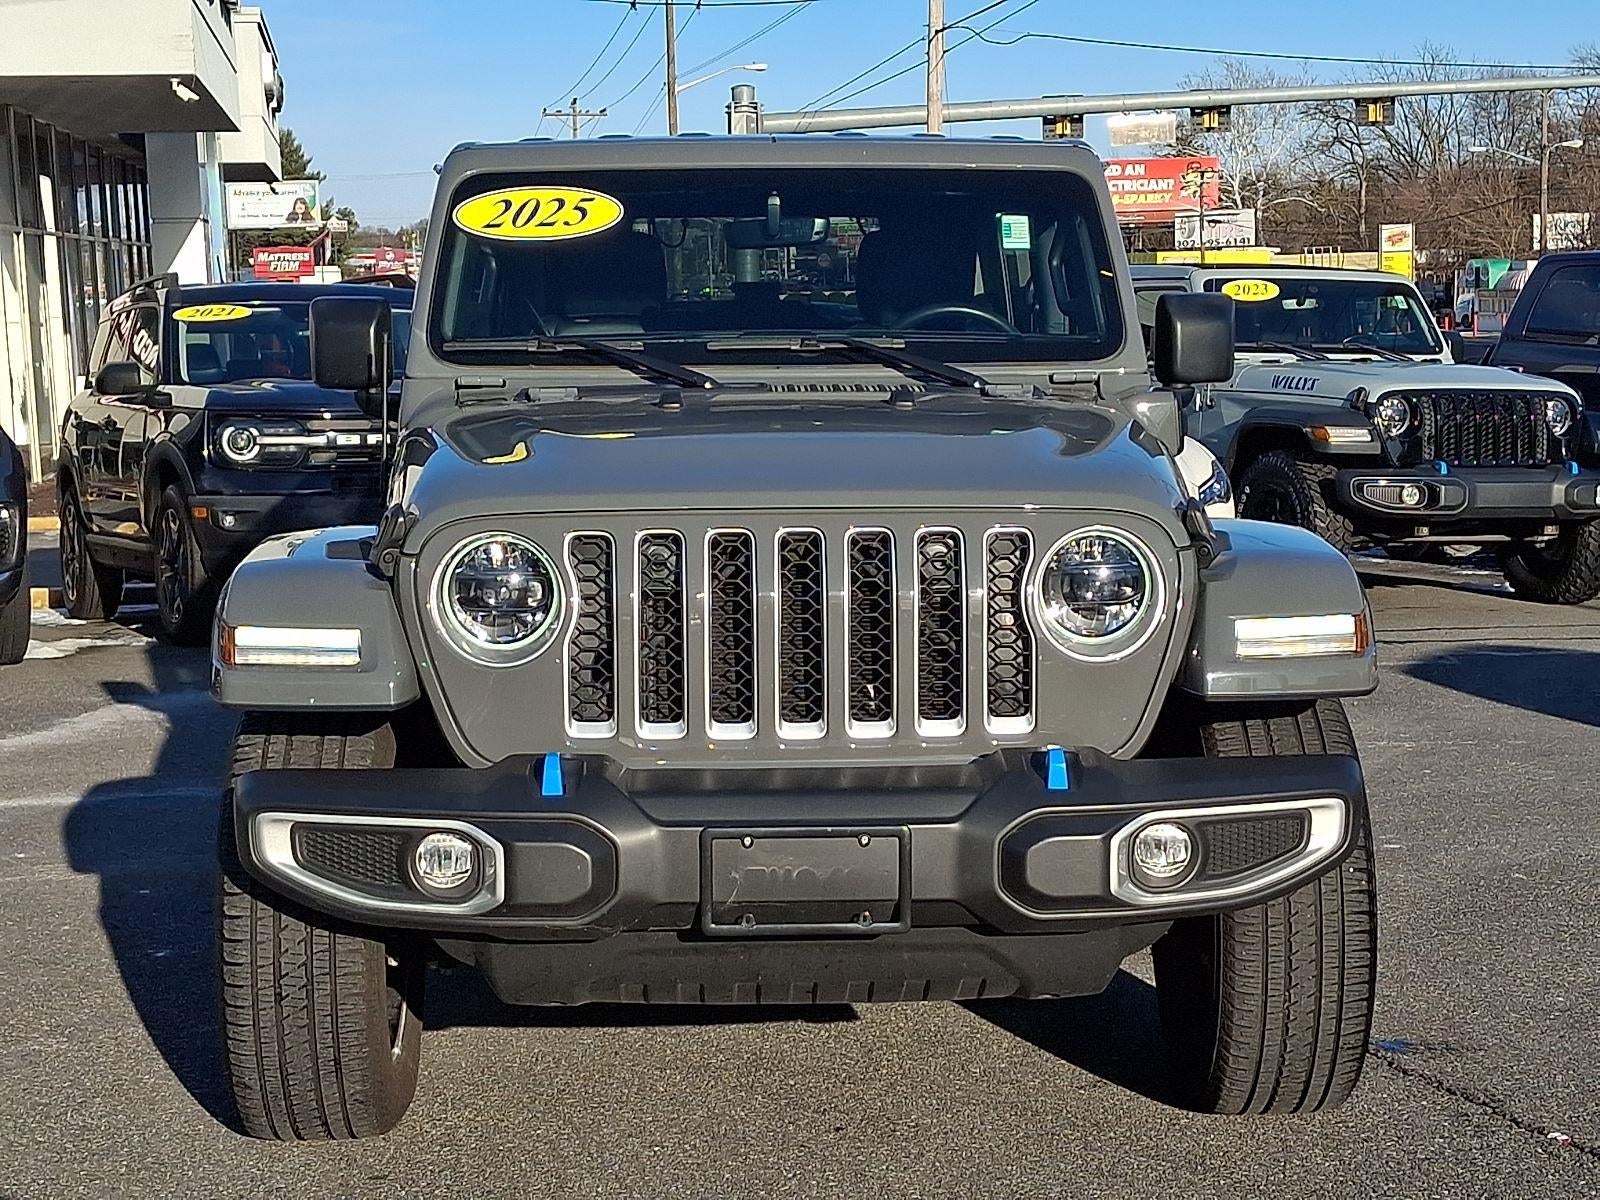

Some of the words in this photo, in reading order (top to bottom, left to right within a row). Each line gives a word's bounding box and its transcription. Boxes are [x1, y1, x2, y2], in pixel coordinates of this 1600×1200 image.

[1124, 163, 1145, 176] AN
[481, 197, 596, 229] 2025
[257, 251, 310, 262] MATTRESS
[269, 261, 300, 272] FIRM
[1233, 283, 1268, 296] 2023
[186, 306, 237, 318] 2021
[1271, 374, 1321, 391] WILLYS
